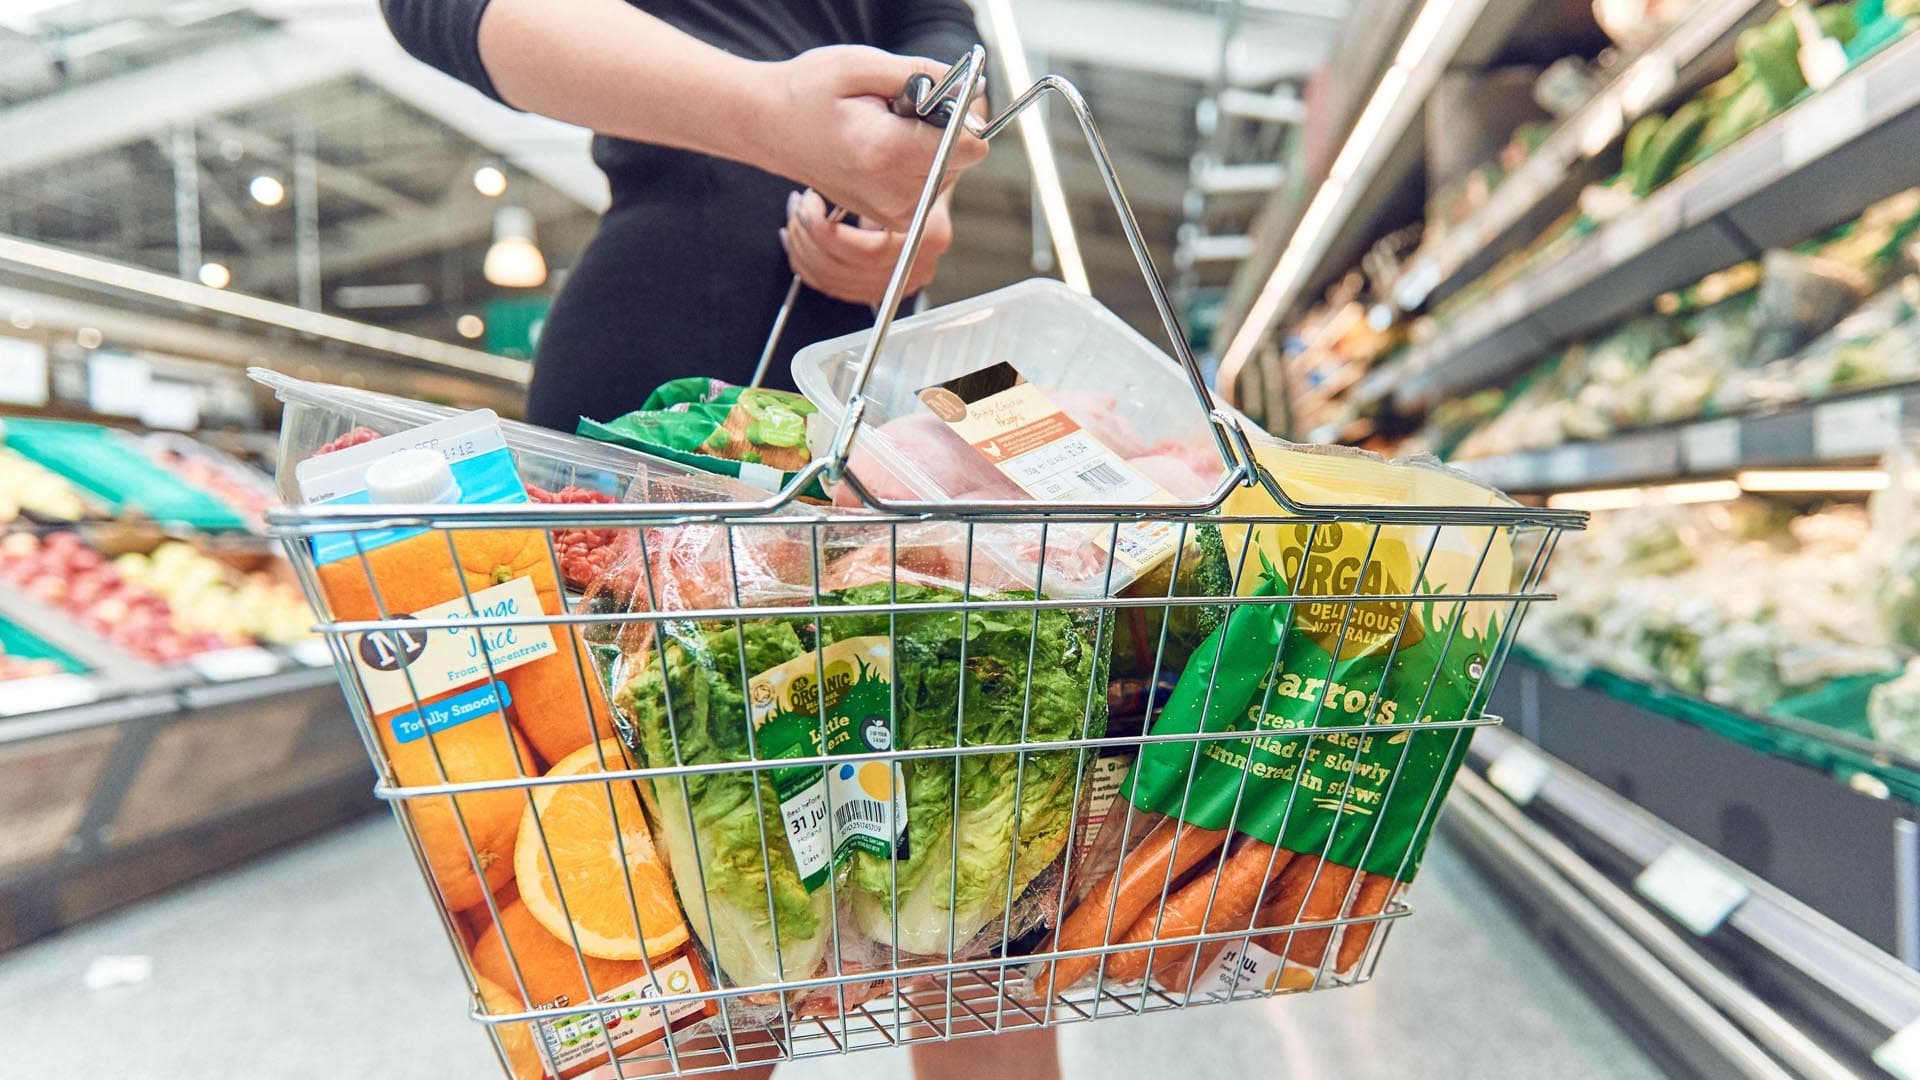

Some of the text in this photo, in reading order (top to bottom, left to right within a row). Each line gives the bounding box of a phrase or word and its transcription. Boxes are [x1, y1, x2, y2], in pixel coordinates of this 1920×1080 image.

[366, 624, 422, 668] M
[447, 640, 548, 681] From cncentrate
[1300, 769, 1323, 792] in
[1327, 781, 1383, 805] stews
[1324, 753, 1391, 787] slowly
[791, 800, 827, 835] 31 Jul
